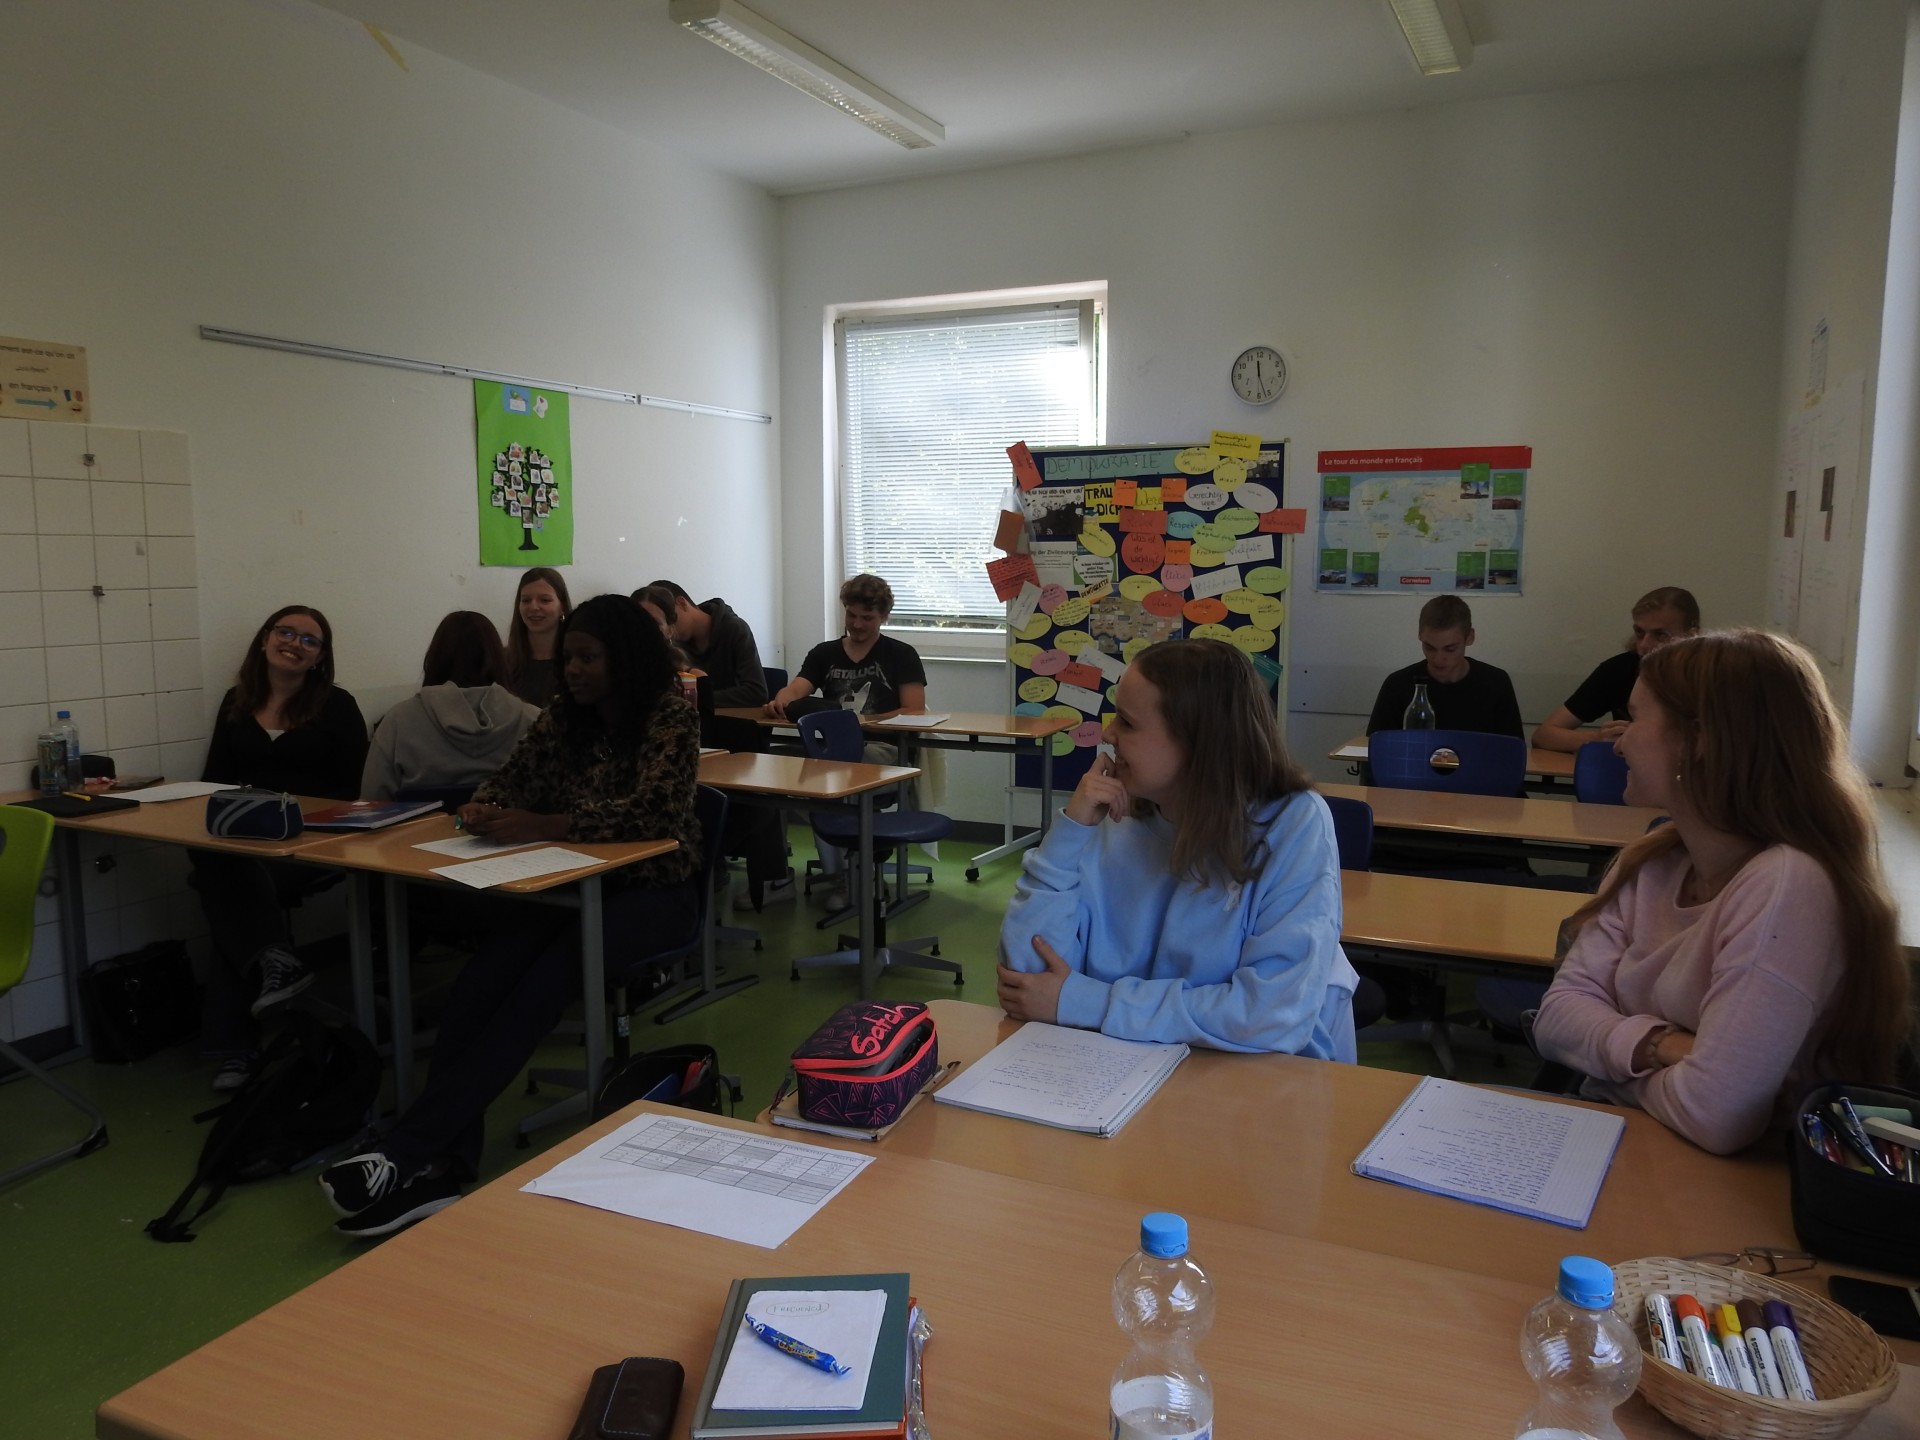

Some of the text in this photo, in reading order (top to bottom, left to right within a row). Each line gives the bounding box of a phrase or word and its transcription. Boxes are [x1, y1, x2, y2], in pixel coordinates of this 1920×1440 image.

[1046, 452, 1162, 474] DEMOKRATIE
[1395, 456, 1423, 465] français
[1085, 487, 1114, 499] TRAU
[1097, 503, 1121, 516] DICH
[1037, 549, 1046, 557] der
[1229, 544, 1262, 559] Vielfalt
[825, 661, 893, 691] METALLICA
